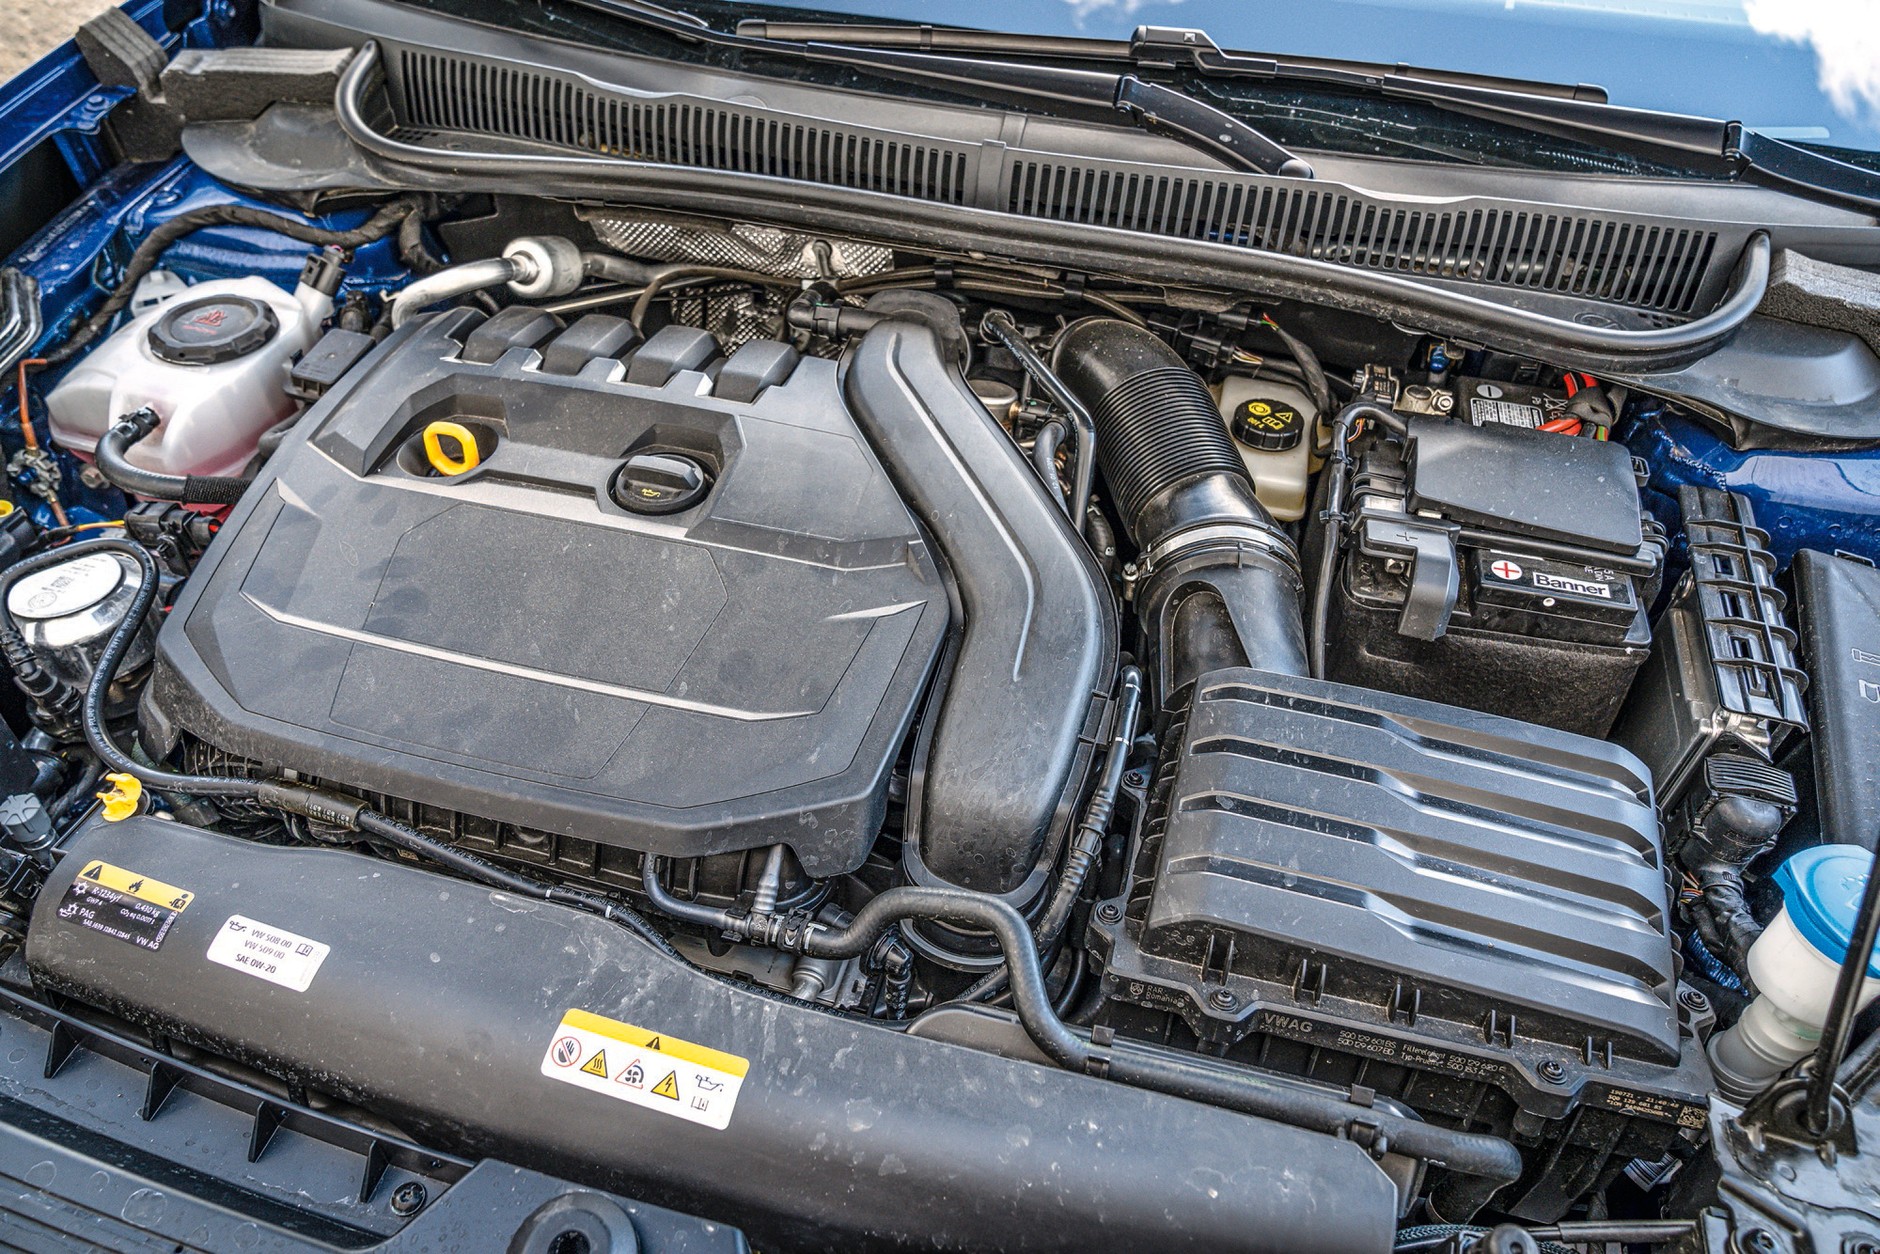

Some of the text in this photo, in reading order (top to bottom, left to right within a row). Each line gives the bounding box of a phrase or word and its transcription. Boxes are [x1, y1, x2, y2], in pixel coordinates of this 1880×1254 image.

[1536, 574, 1606, 596] Banner
[91, 886, 161, 918] R-1234yf 0.430 kg
[79, 907, 95, 919] PAG
[136, 935, 160, 950] VW AG
[252, 929, 293, 949] VW 508 00
[244, 940, 285, 960] VW 509 00
[235, 953, 277, 974] SAE 0W-20
[1145, 991, 1178, 1005] Romania
